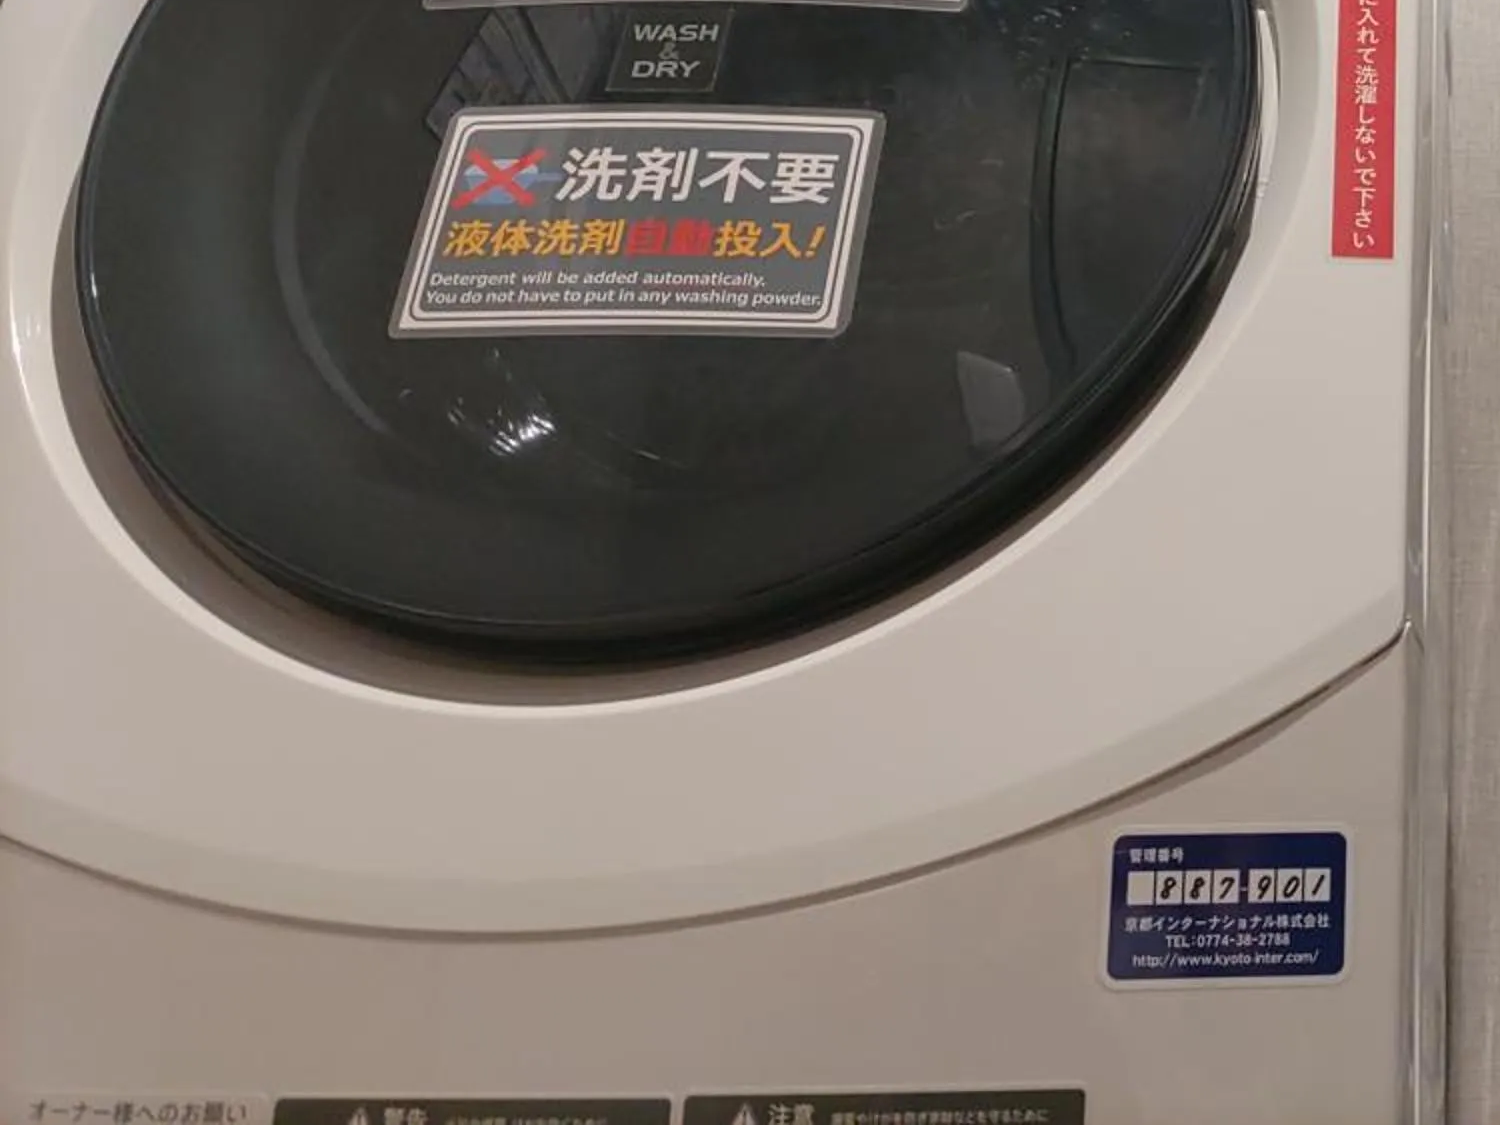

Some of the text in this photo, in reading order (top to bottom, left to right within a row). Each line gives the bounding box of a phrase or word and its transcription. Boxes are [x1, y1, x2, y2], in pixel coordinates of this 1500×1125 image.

[634, 23, 719, 42] WASH
[660, 41, 680, 60] &
[631, 60, 701, 78] DRY
[555, 146, 841, 205] 洗剤不要
[429, 270, 767, 289] Detergent will be added automatically.
[425, 288, 824, 308] You do not have to put in any washing powder.
[1129, 847, 1185, 864] 管理番号
[1124, 913, 1330, 932] 京都インターナショナル株式会社
[1132, 949, 1320, 968] http://www.kyoto-inter.com/
[28, 1103, 248, 1124] オーナー様へのお願い
